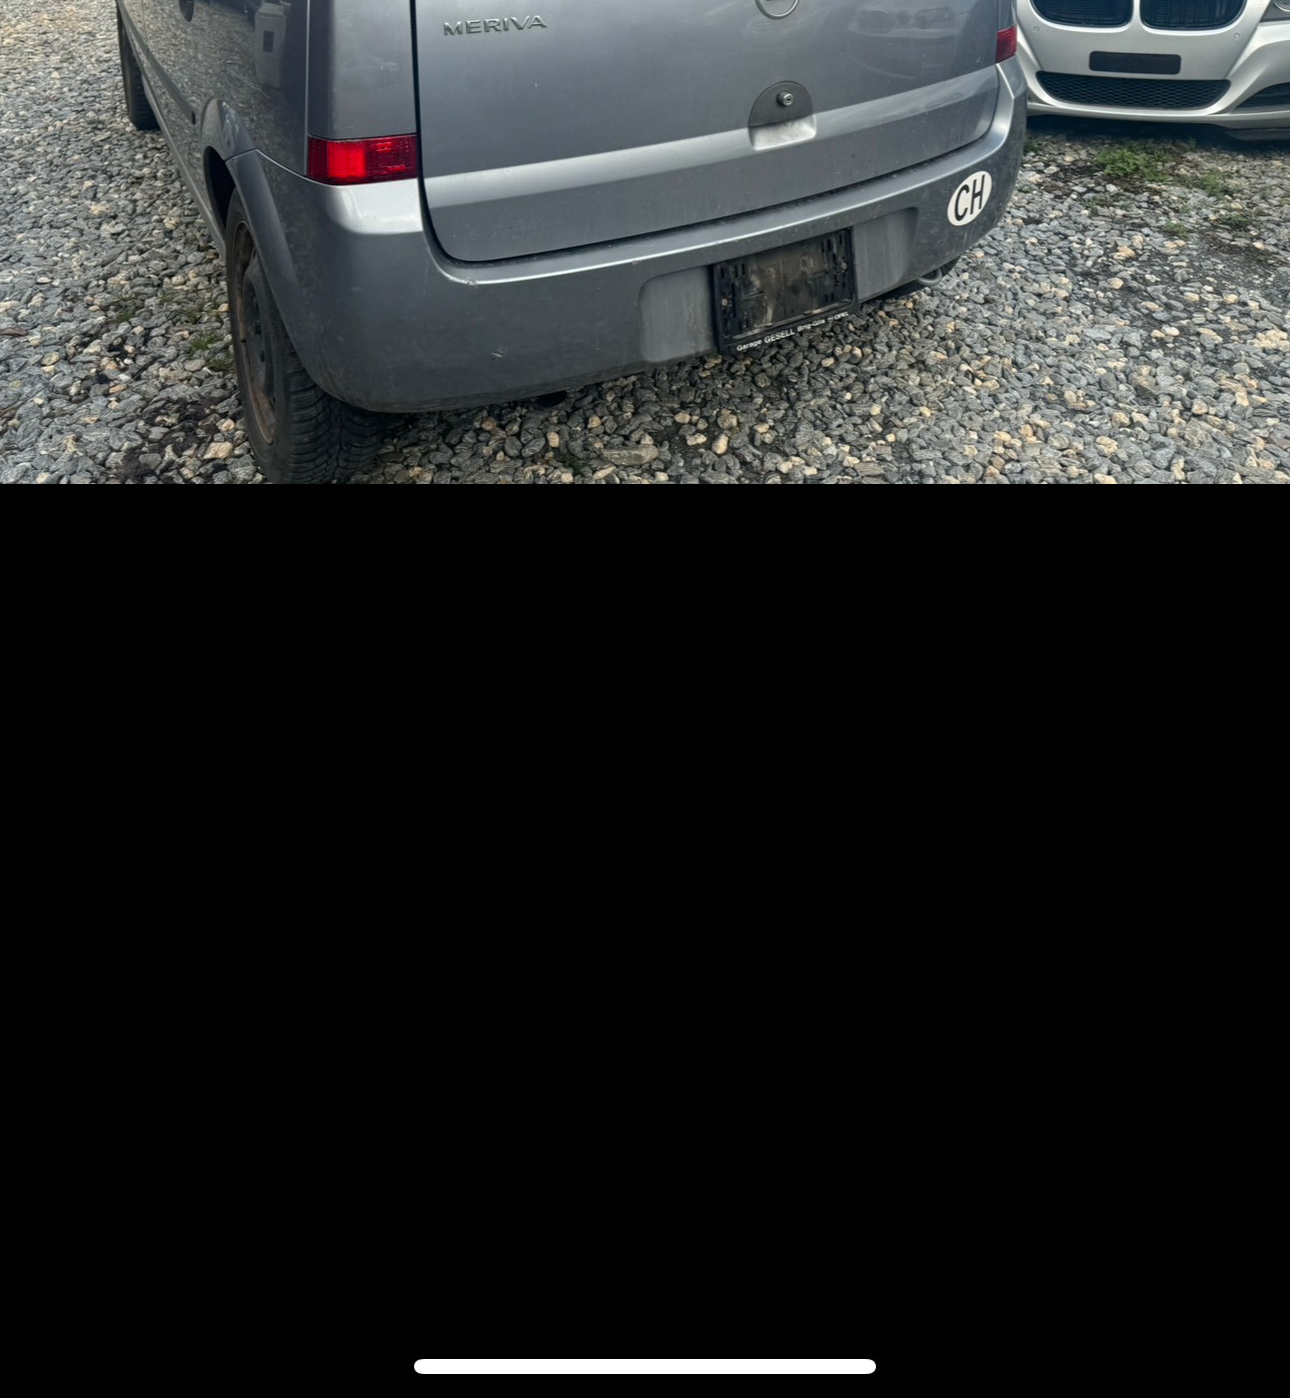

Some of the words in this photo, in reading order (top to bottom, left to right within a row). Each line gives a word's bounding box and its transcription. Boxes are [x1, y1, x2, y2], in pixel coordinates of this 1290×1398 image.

[443, 15, 547, 35] MERIVA
[954, 174, 986, 221] CH
[736, 339, 762, 351] Garage
[764, 329, 795, 343] GESELL
